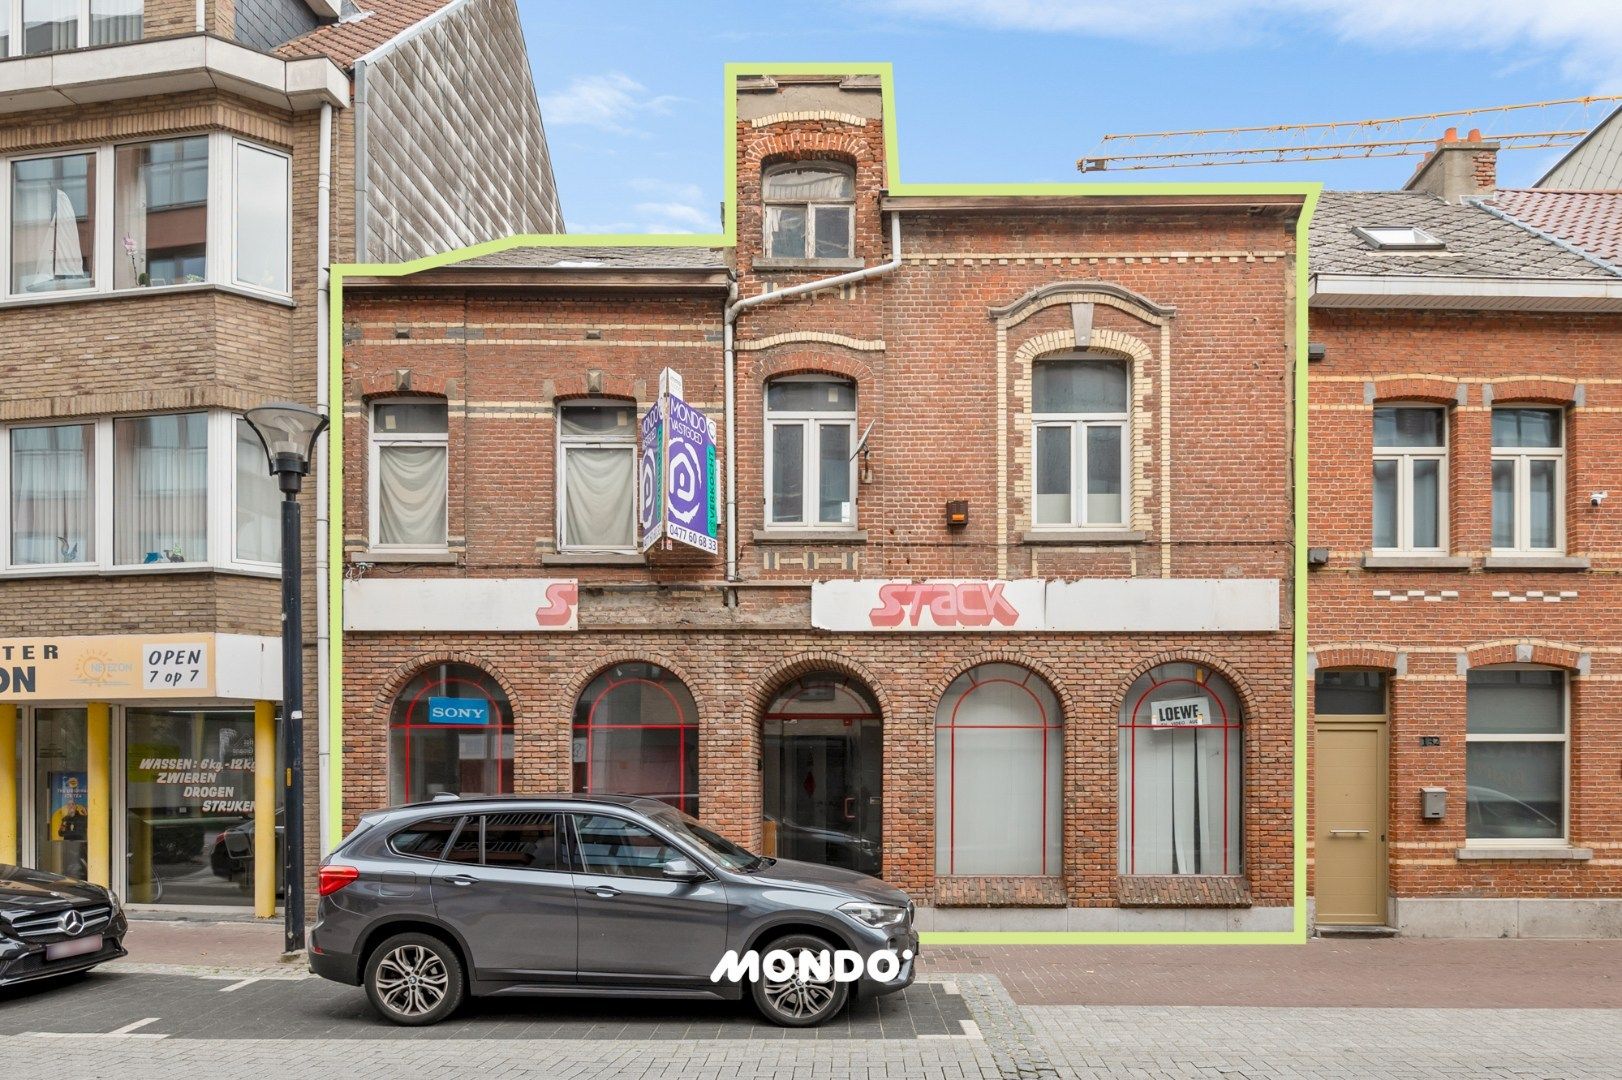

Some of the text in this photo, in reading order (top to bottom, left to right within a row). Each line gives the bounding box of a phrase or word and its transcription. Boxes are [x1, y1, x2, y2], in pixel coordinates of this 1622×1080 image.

[670, 398, 706, 434] MONDO
[669, 417, 703, 445] VASTGOED
[669, 524, 687, 540] 0477
[688, 531, 698, 544] 60
[698, 534, 707, 548] 68
[708, 538, 717, 551] 33
[2, 644, 58, 660] TER
[148, 649, 202, 666] OPEN
[149, 669, 199, 687] 7 op 7
[432, 706, 485, 719] SONY
[1158, 704, 1199, 722] LOEWE
[156, 772, 218, 784] ZWIEREN
[183, 786, 235, 798] DROGEN
